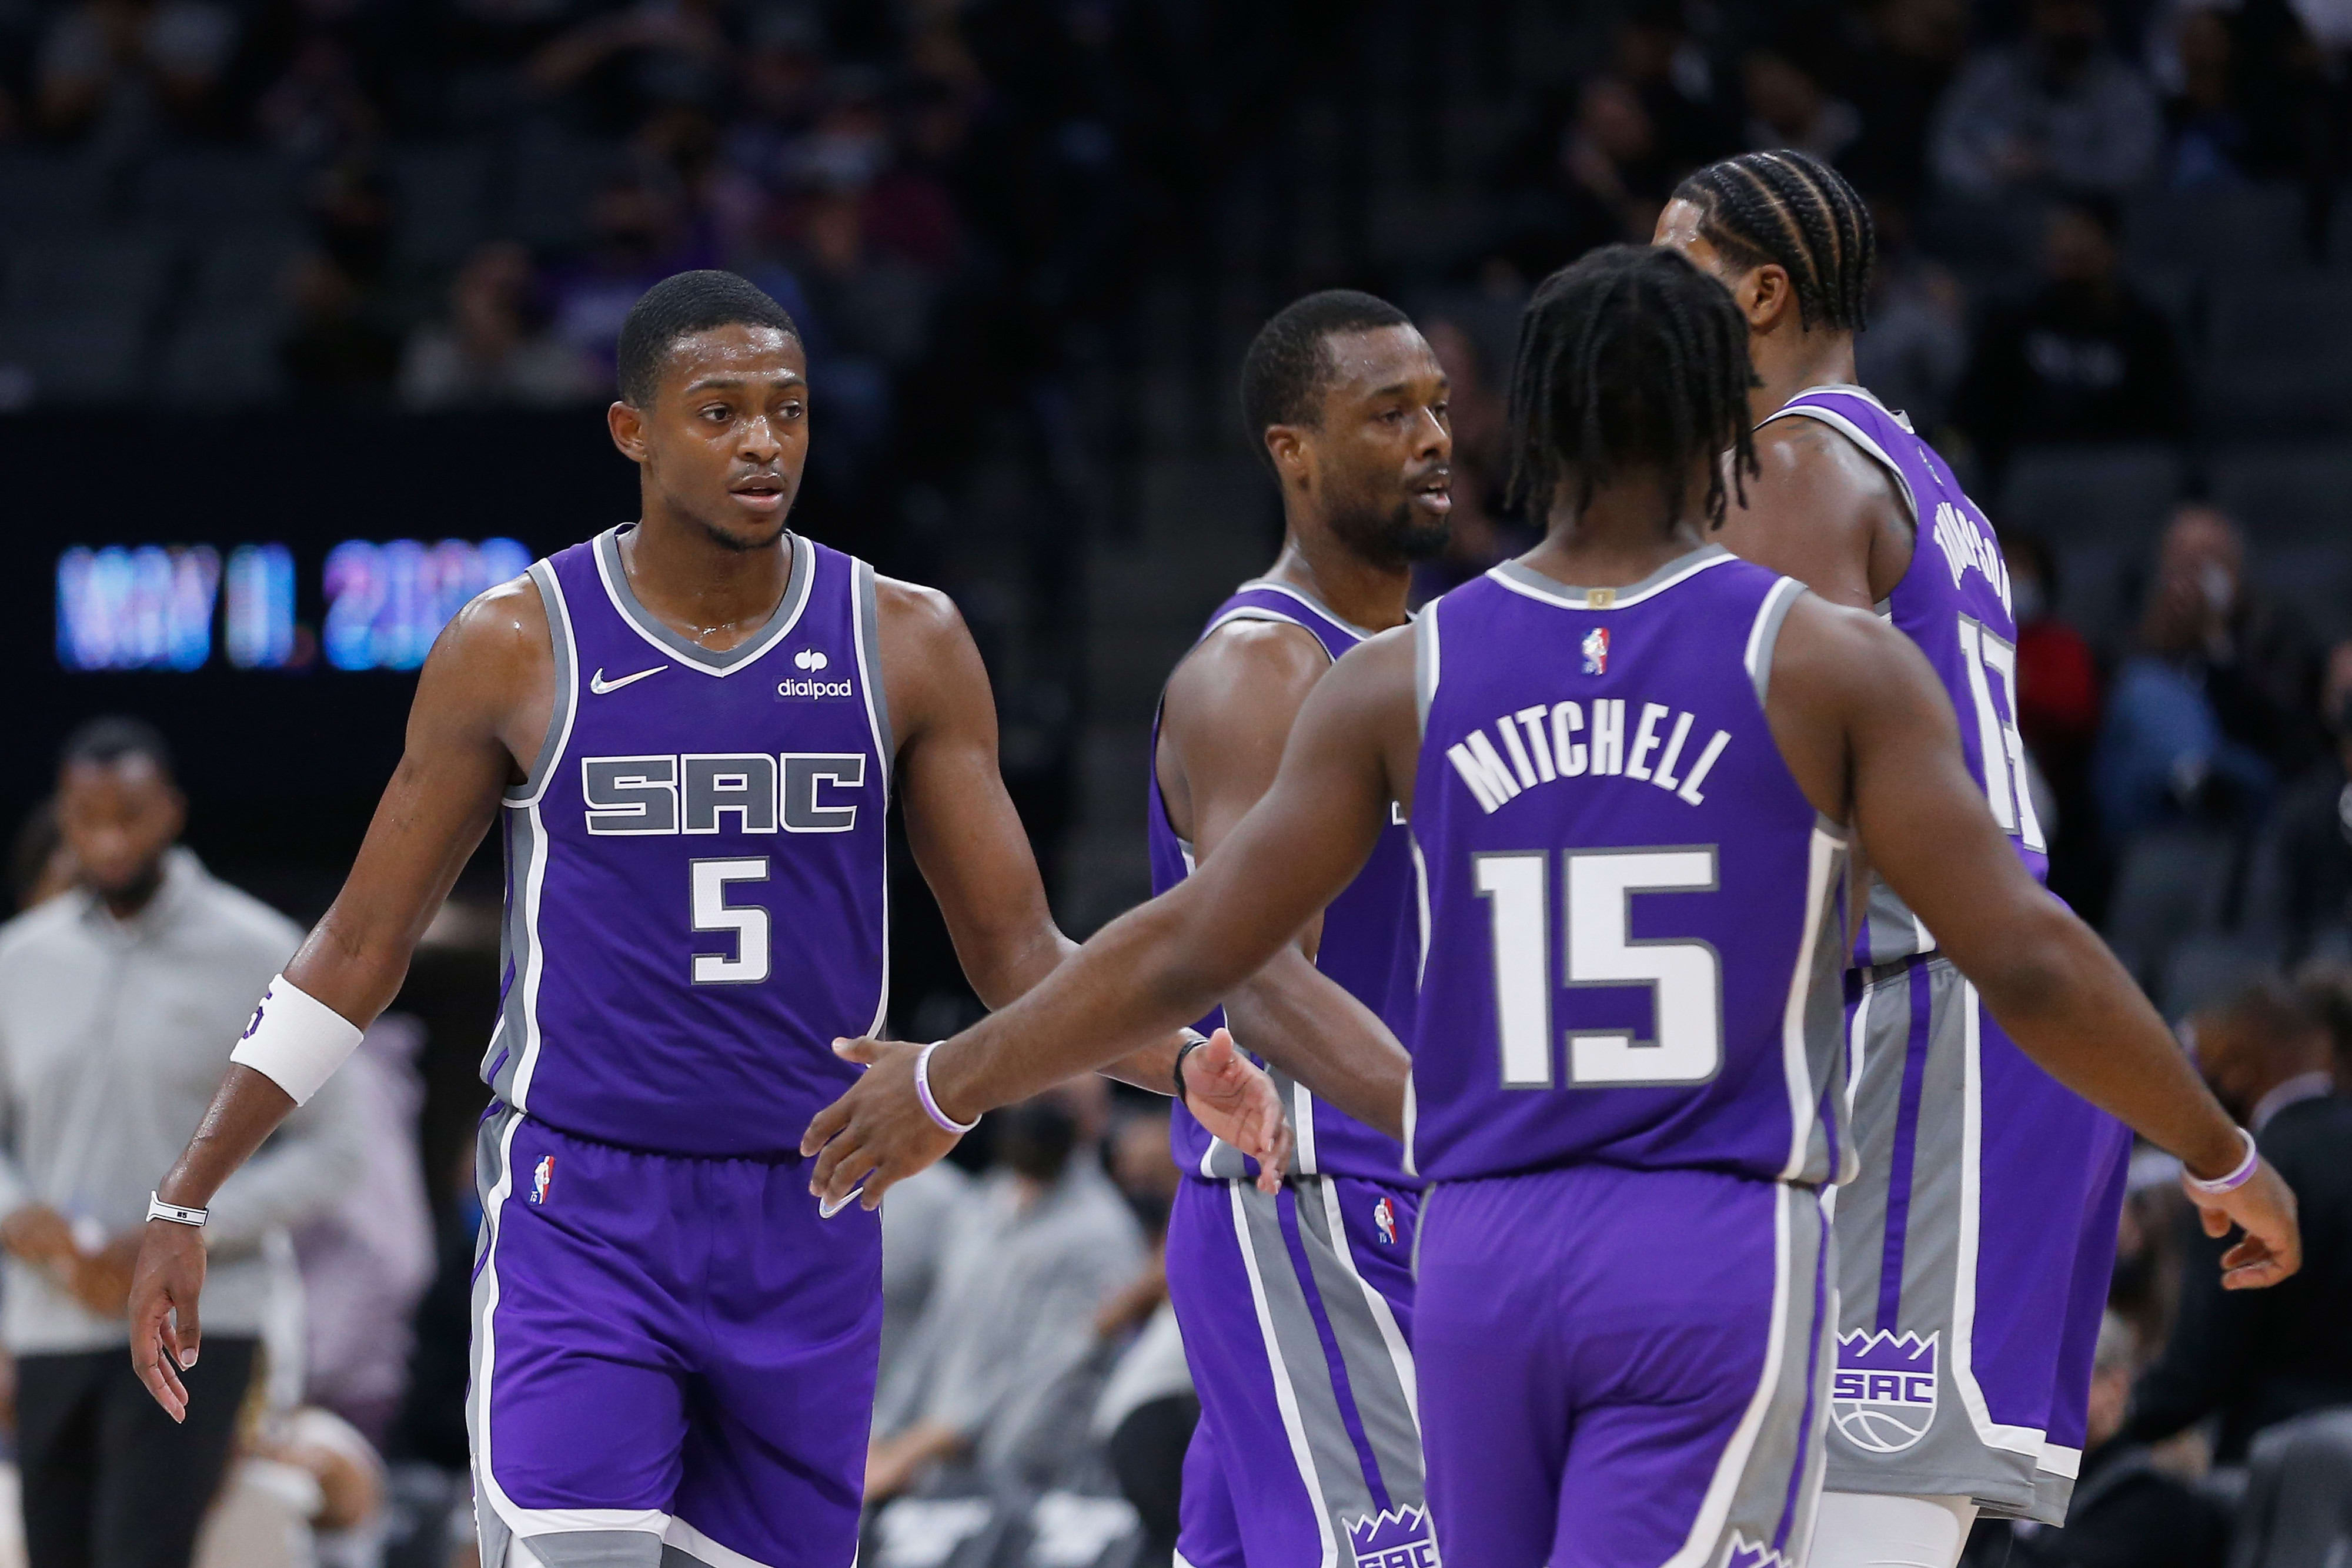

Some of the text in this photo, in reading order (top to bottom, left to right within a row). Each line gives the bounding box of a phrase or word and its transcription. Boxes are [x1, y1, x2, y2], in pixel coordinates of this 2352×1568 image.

[777, 678, 852, 700] dialpad
[582, 753, 866, 835] SAC
[1446, 698, 1732, 815] MITCHELL
[689, 856, 772, 985] 5
[1471, 844, 1725, 1091] 15
[1833, 1374, 1933, 1403] SAC
